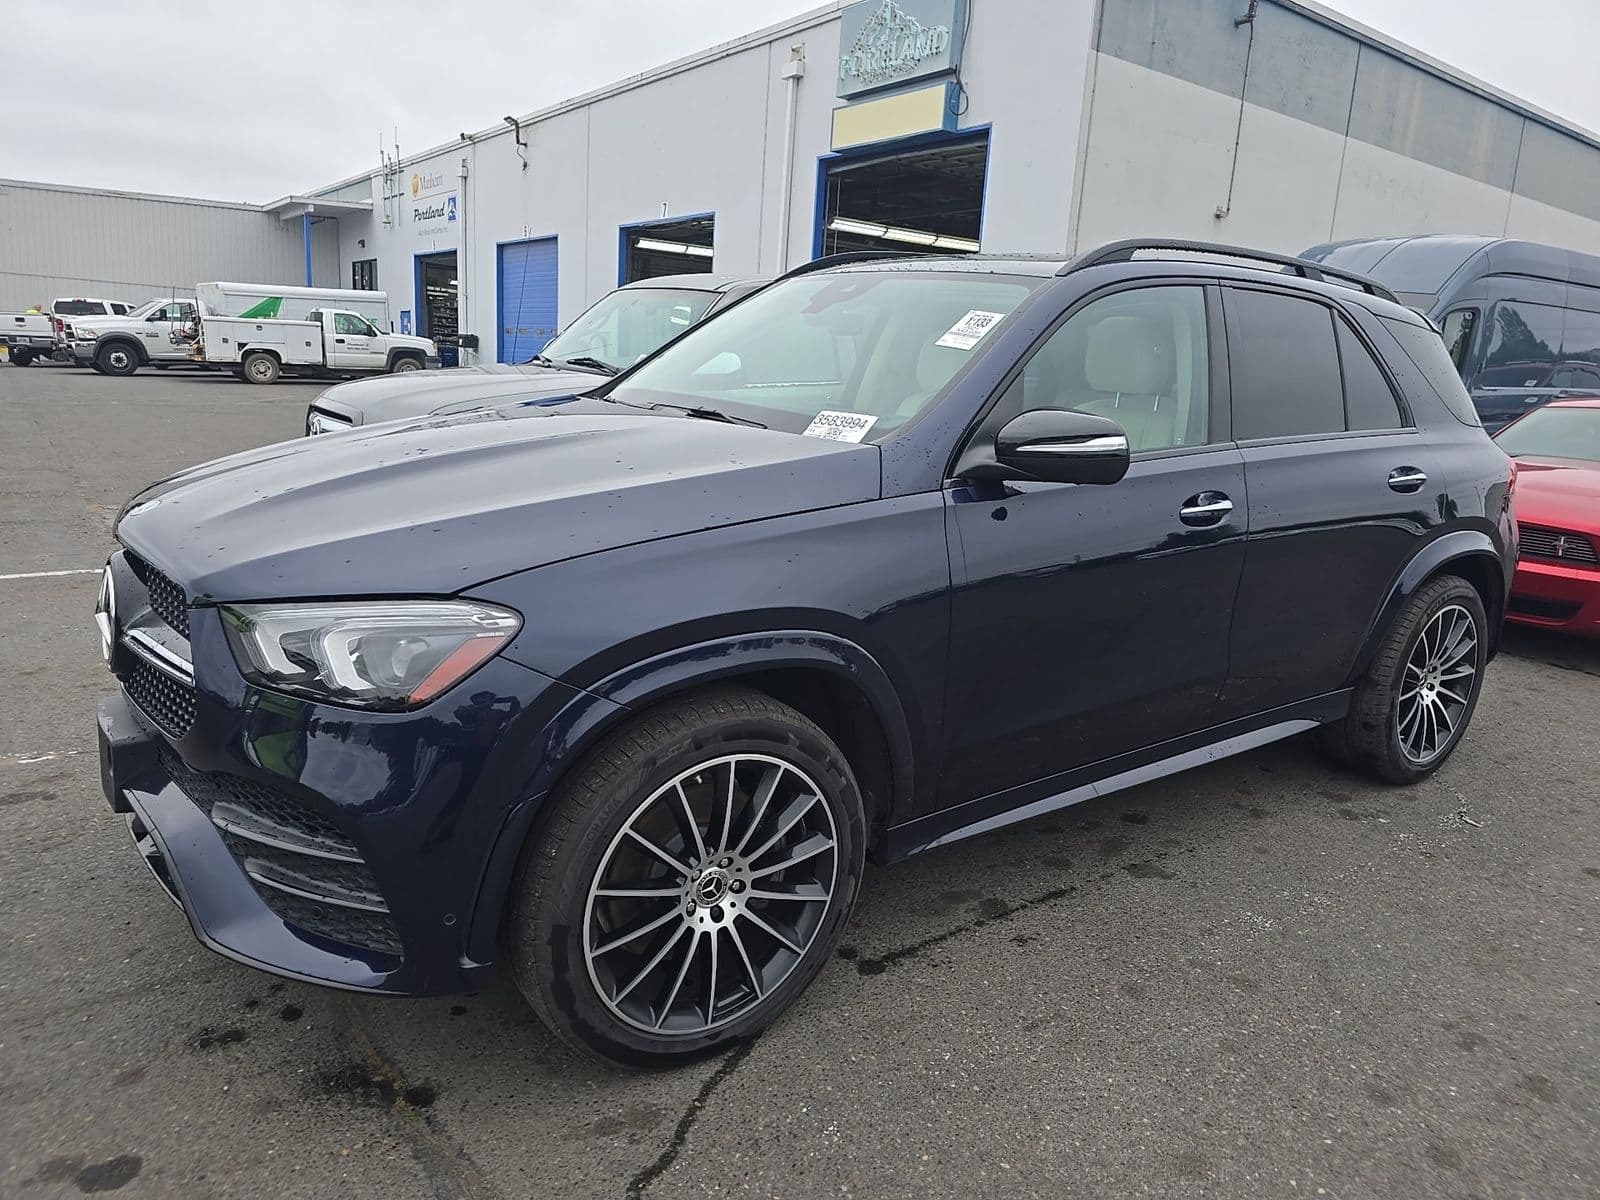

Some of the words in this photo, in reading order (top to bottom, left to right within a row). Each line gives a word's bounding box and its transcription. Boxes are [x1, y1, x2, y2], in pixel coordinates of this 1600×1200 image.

[840, 26, 949, 80] PORTLAND
[413, 202, 446, 222] Portland
[813, 414, 868, 430] 3583994
[576, 797, 623, 862] OKOHAMA
